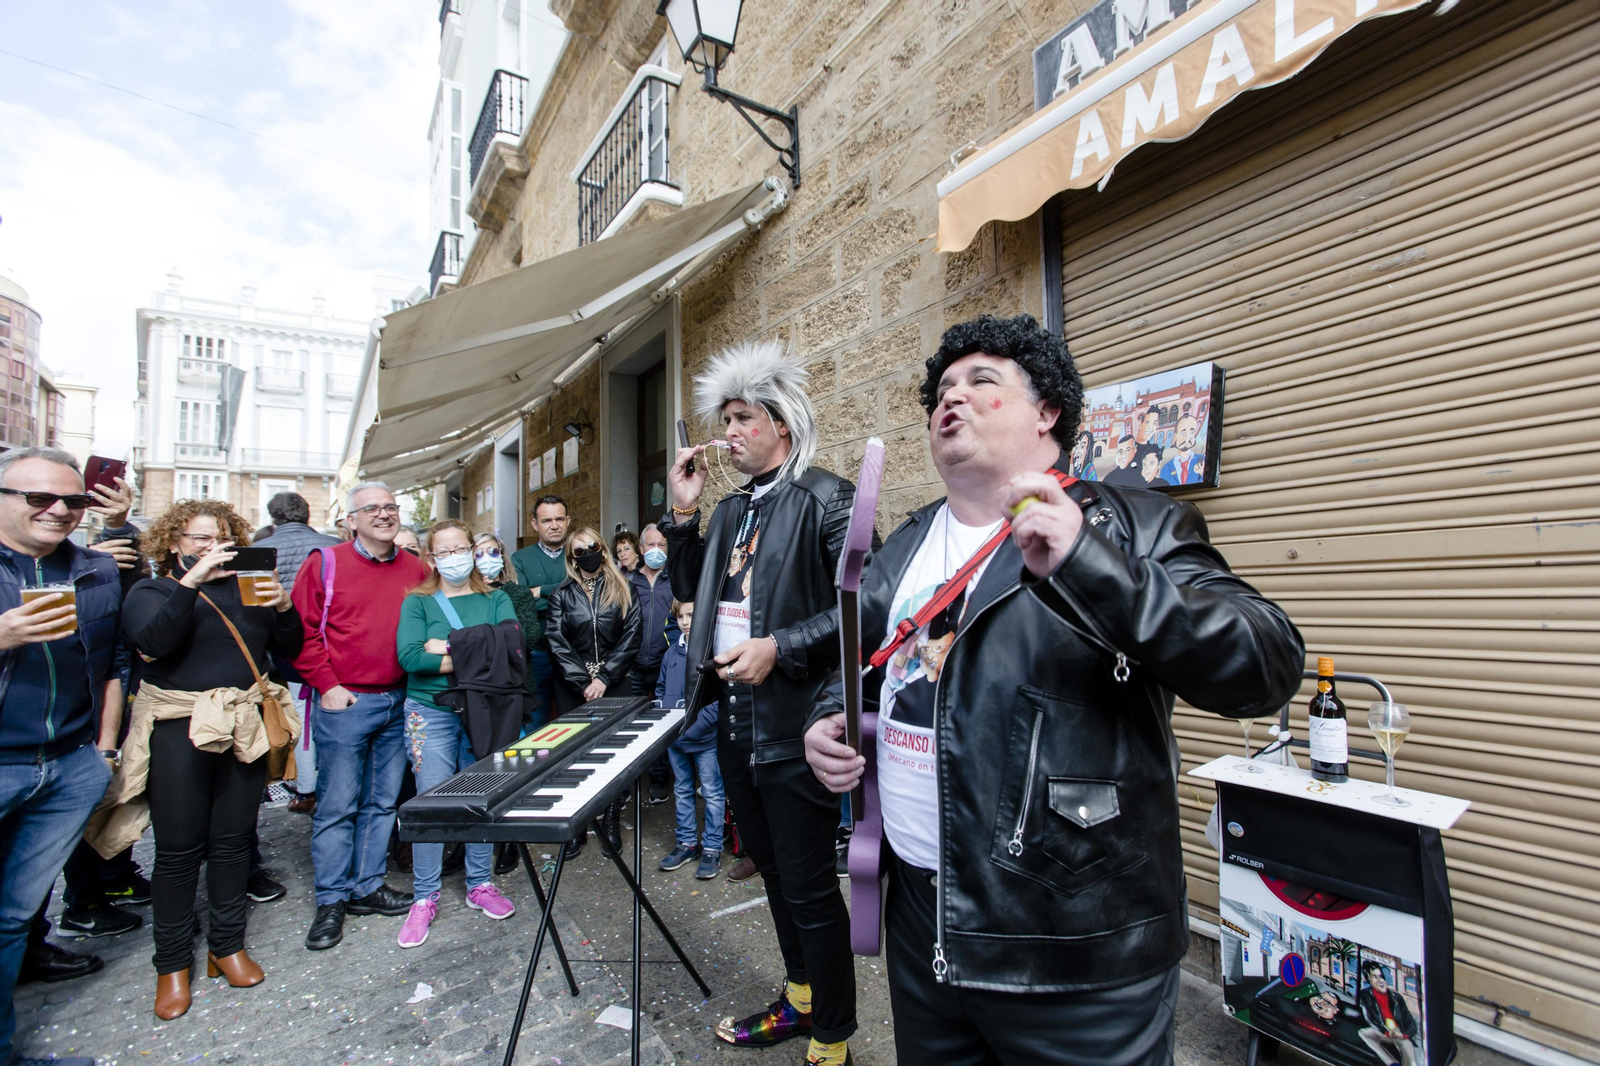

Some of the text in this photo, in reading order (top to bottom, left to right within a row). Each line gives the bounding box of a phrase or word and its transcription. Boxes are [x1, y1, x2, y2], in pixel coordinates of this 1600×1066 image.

[1053, 0, 1202, 100] AM
[1070, 0, 1378, 181] AMAL
[884, 727, 929, 753] DESCANSO
[888, 752, 915, 769] (Mecano
[918, 763, 928, 771] en
[1236, 855, 1264, 870] ROLSER
